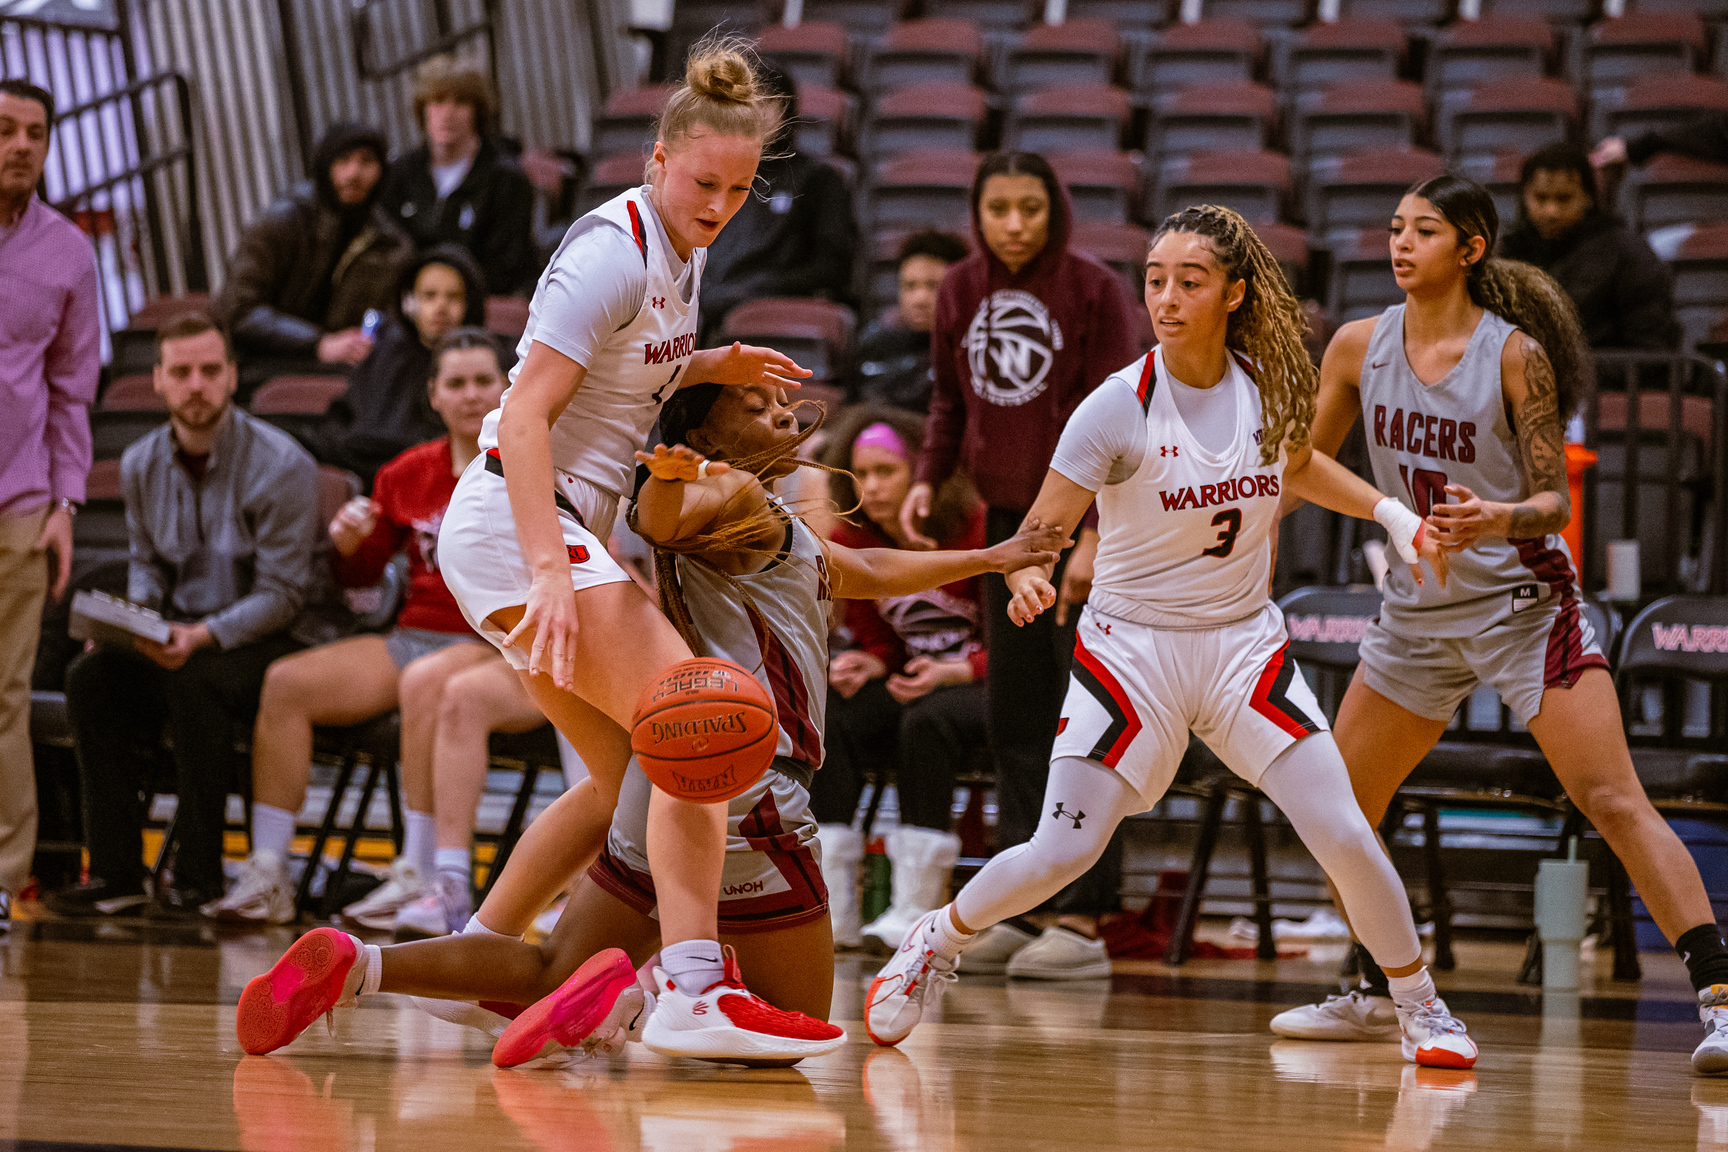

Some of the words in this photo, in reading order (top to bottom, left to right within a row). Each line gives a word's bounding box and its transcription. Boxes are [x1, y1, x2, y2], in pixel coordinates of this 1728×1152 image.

[644, 332, 697, 365] WARRIO
[1374, 404, 1476, 464] RACERS
[1159, 474, 1280, 511] WARRIORS
[1202, 507, 1242, 559] 3
[1520, 587, 1531, 597] M
[653, 676, 738, 703] LEGACY
[652, 711, 747, 745] SPALDING
[723, 880, 764, 896] UNOH
